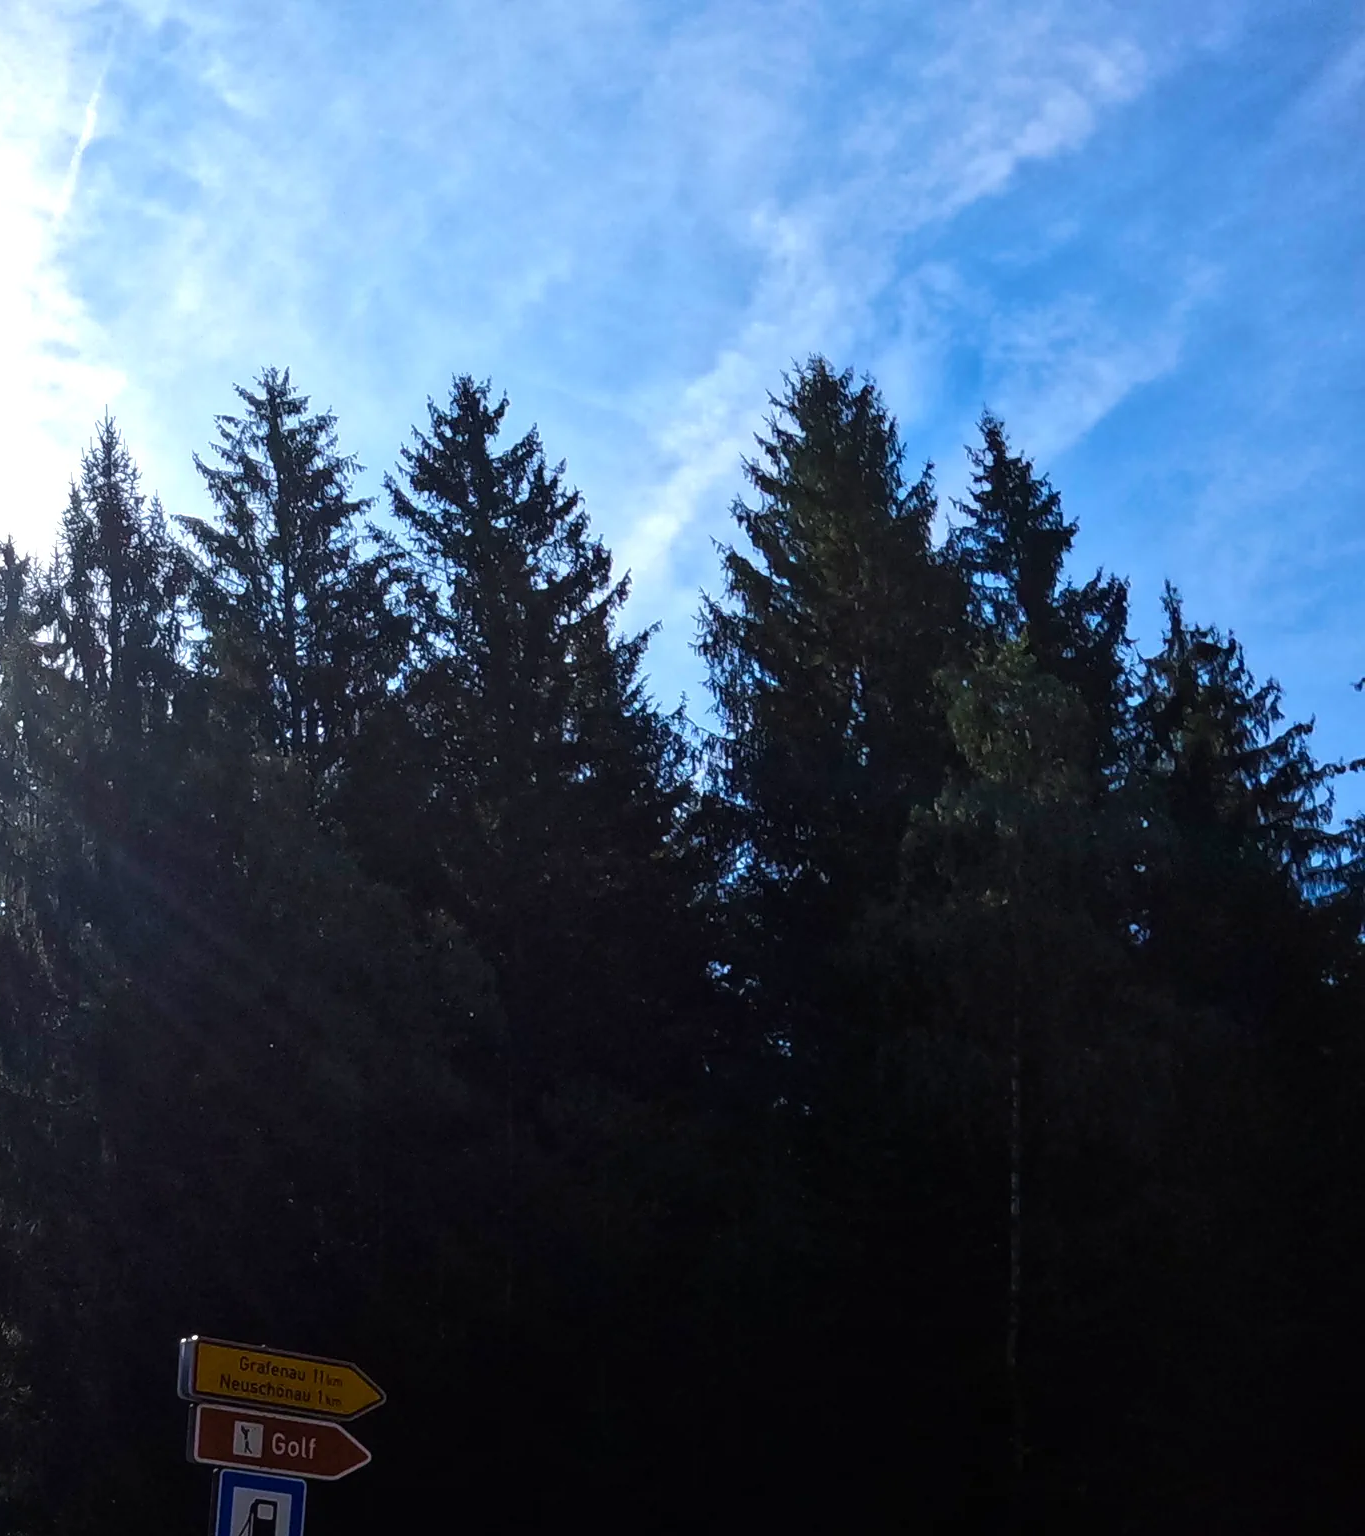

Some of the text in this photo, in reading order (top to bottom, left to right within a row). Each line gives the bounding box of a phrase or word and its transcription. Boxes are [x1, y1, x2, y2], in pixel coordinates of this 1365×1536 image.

[239, 1355, 306, 1382] Grafenau
[219, 1372, 312, 1403] Neuschönau
[271, 1432, 317, 1460] Golf
